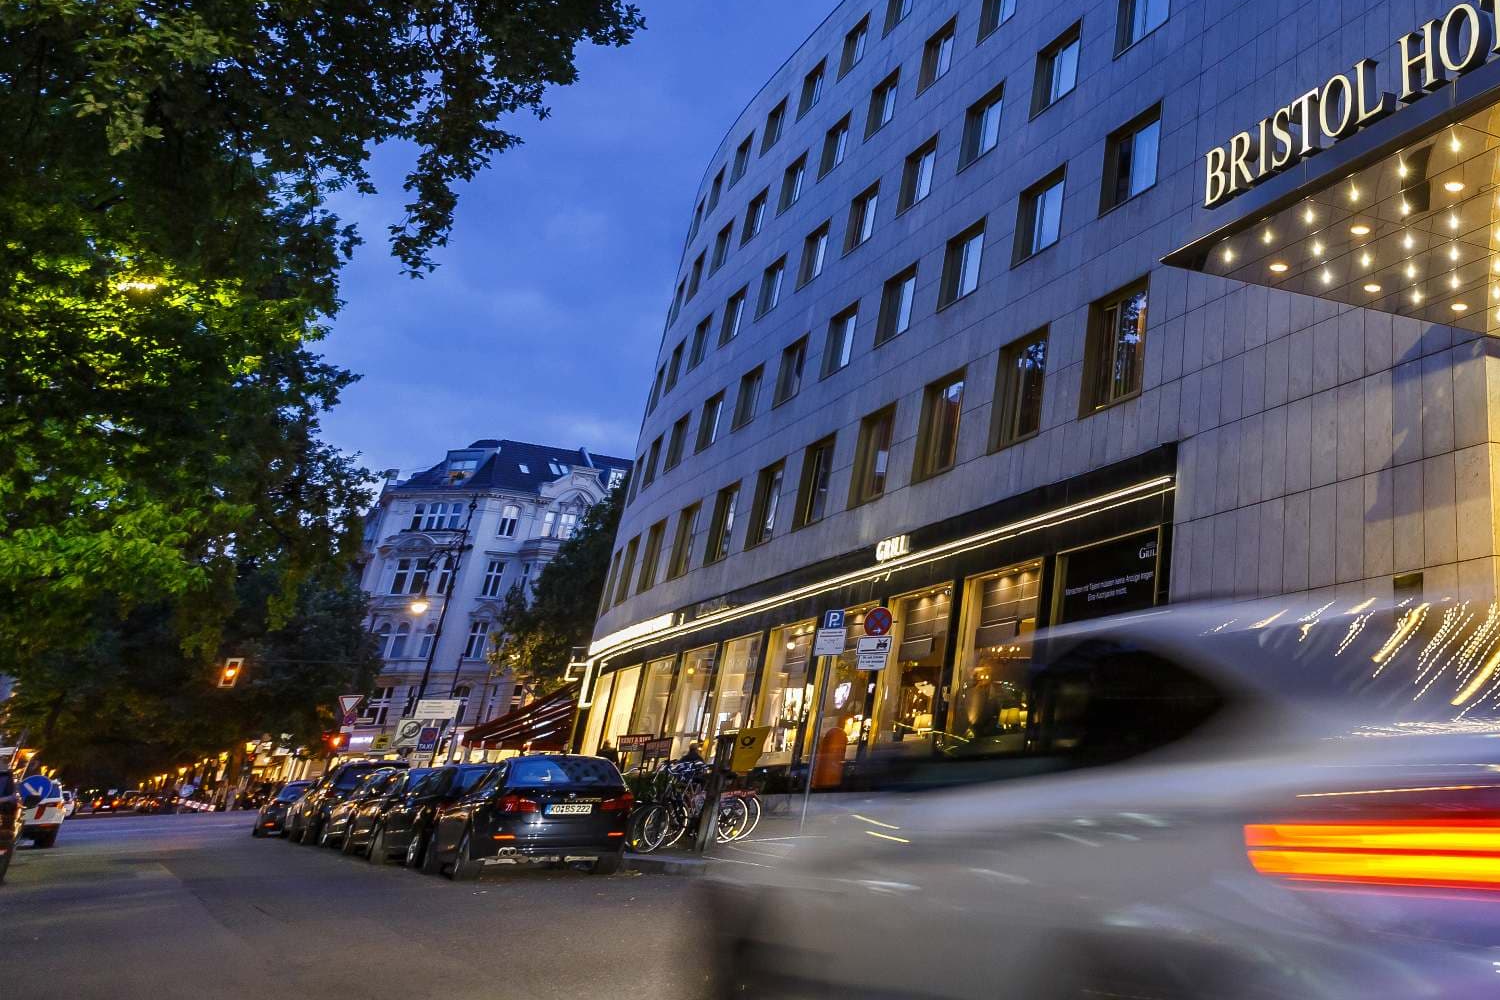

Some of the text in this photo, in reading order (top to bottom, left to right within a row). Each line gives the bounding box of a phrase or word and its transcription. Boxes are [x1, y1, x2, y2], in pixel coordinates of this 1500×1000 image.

[1203, 57, 1397, 209] BRISTOL
[875, 534, 911, 561] GRILL
[828, 612, 840, 627] P
[405, 725, 418, 735] 30
